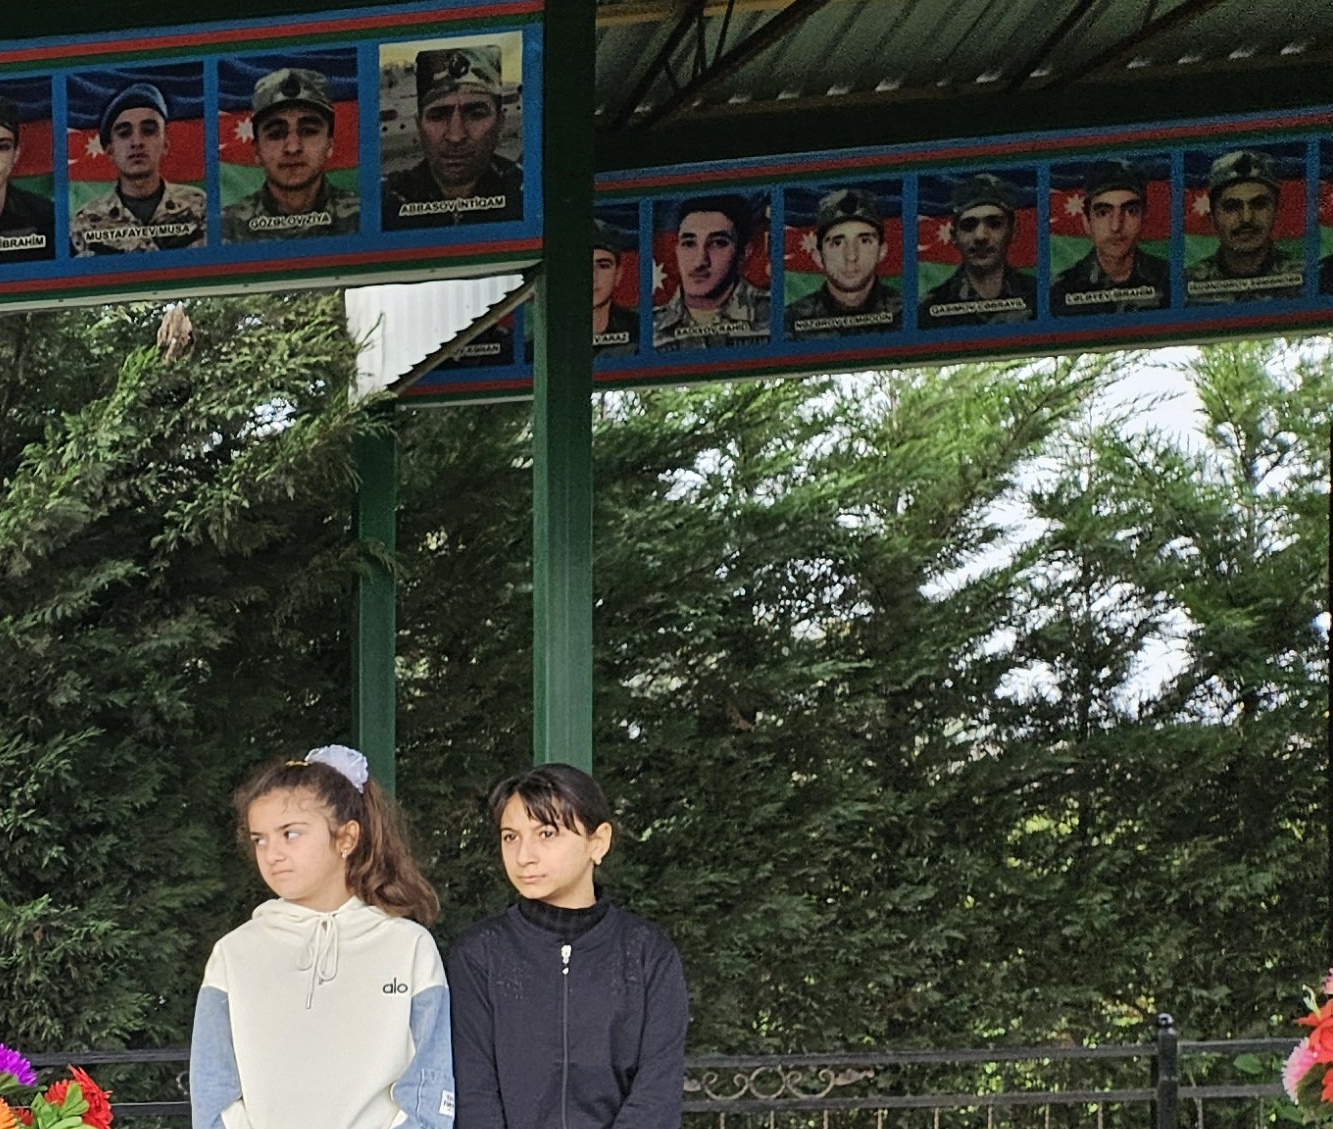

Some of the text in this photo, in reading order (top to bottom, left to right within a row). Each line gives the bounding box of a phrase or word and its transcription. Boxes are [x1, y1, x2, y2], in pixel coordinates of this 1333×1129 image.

[86, 225, 189, 241] MUSTAFAYEV MUSA
[0, 235, 44, 249] İBRAHİM
[383, 977, 408, 994] alo
